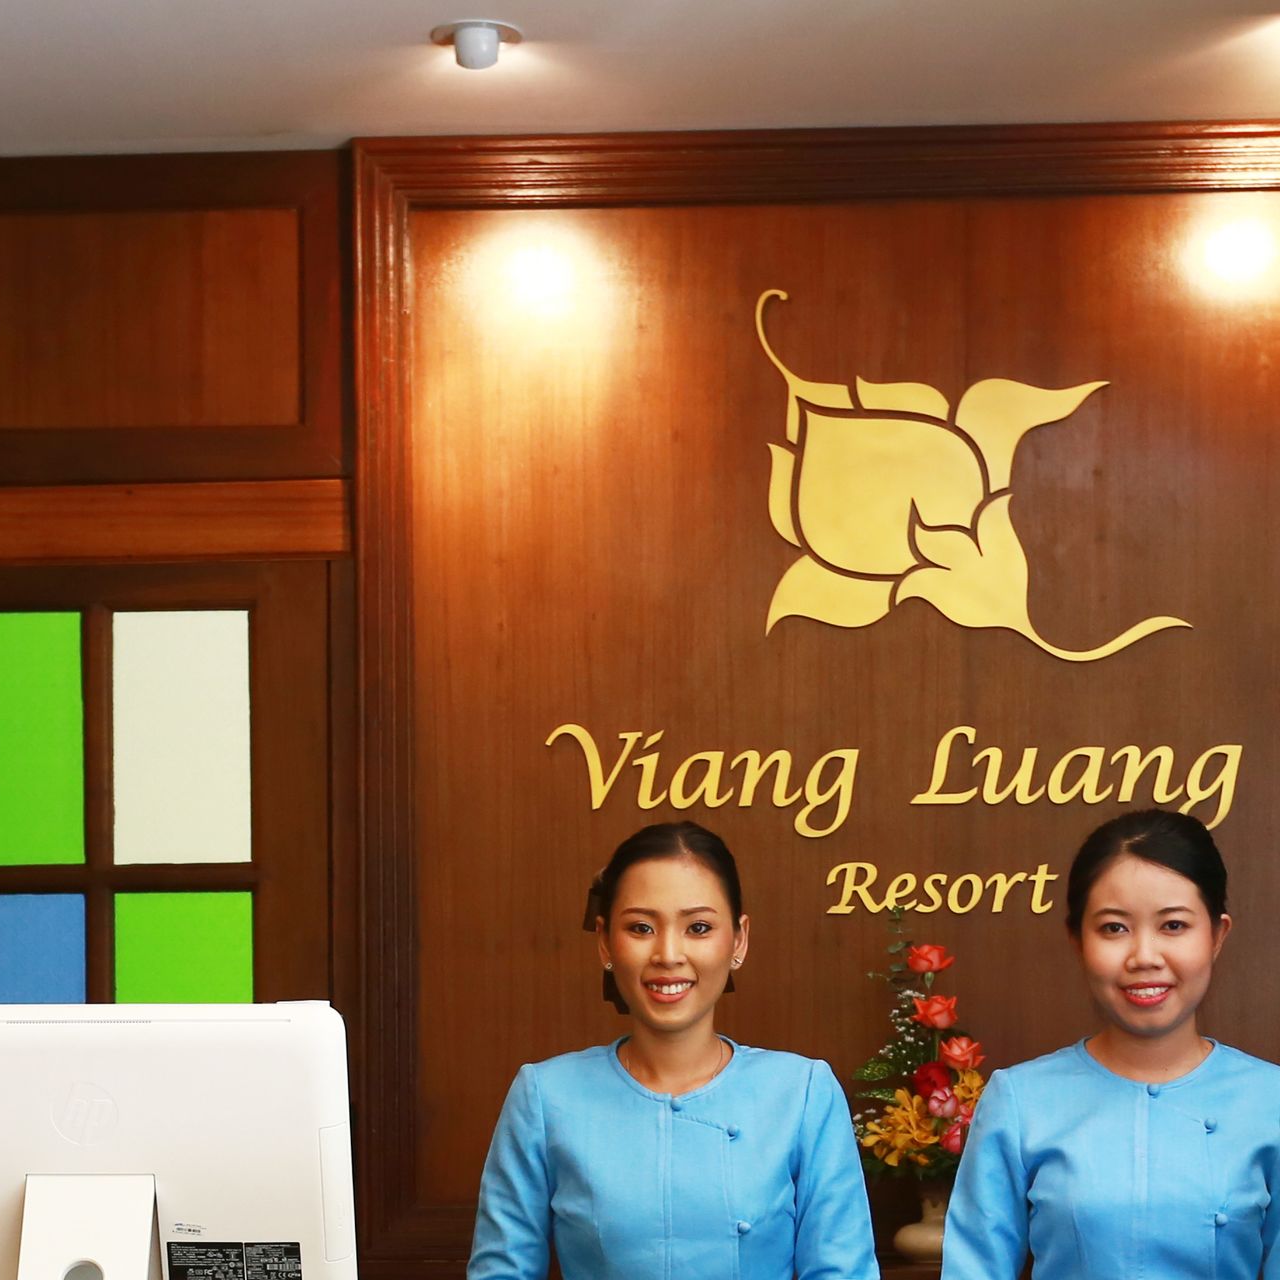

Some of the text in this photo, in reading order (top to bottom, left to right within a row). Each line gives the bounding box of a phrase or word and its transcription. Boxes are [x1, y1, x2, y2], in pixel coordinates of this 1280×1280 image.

[545, 723, 1243, 838] Viang Luang
[826, 861, 1058, 915] Resort
